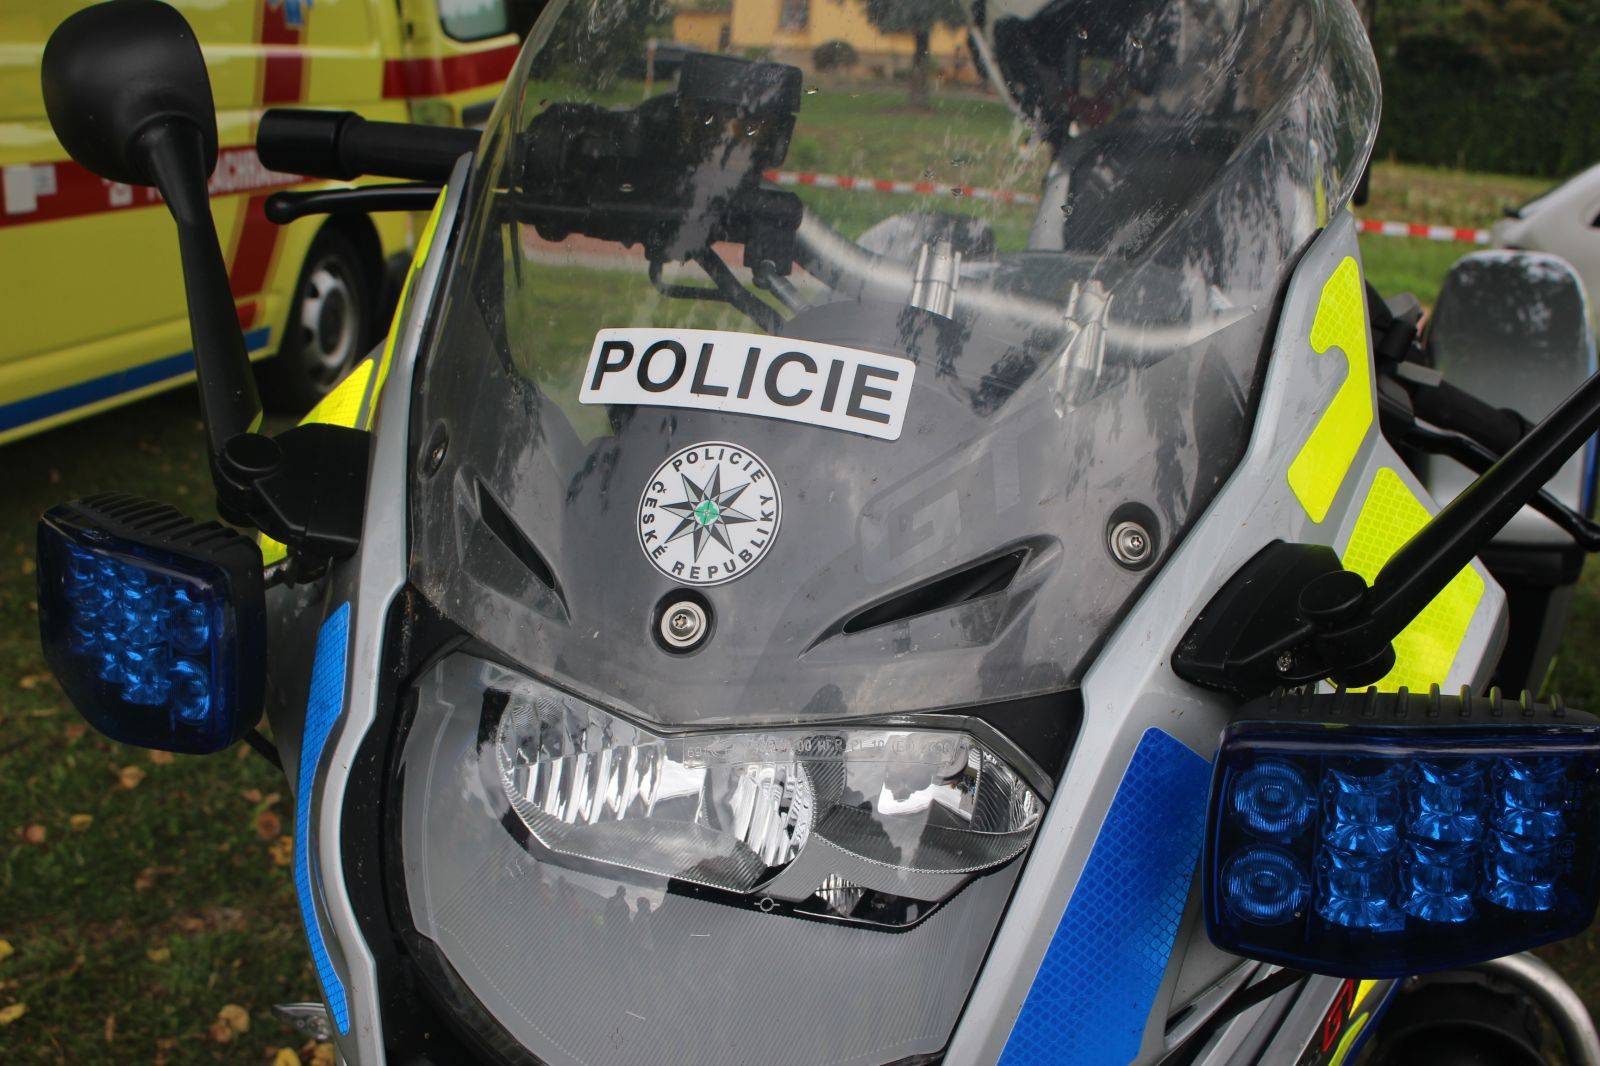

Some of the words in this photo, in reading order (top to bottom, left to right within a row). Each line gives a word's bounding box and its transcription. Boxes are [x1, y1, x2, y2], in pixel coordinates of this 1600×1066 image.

[590, 339, 900, 425] POLICIE
[672, 448, 765, 483] POLICIE
[642, 480, 669, 560] ČESKÉ
[671, 494, 775, 580] REPUBLIKY
